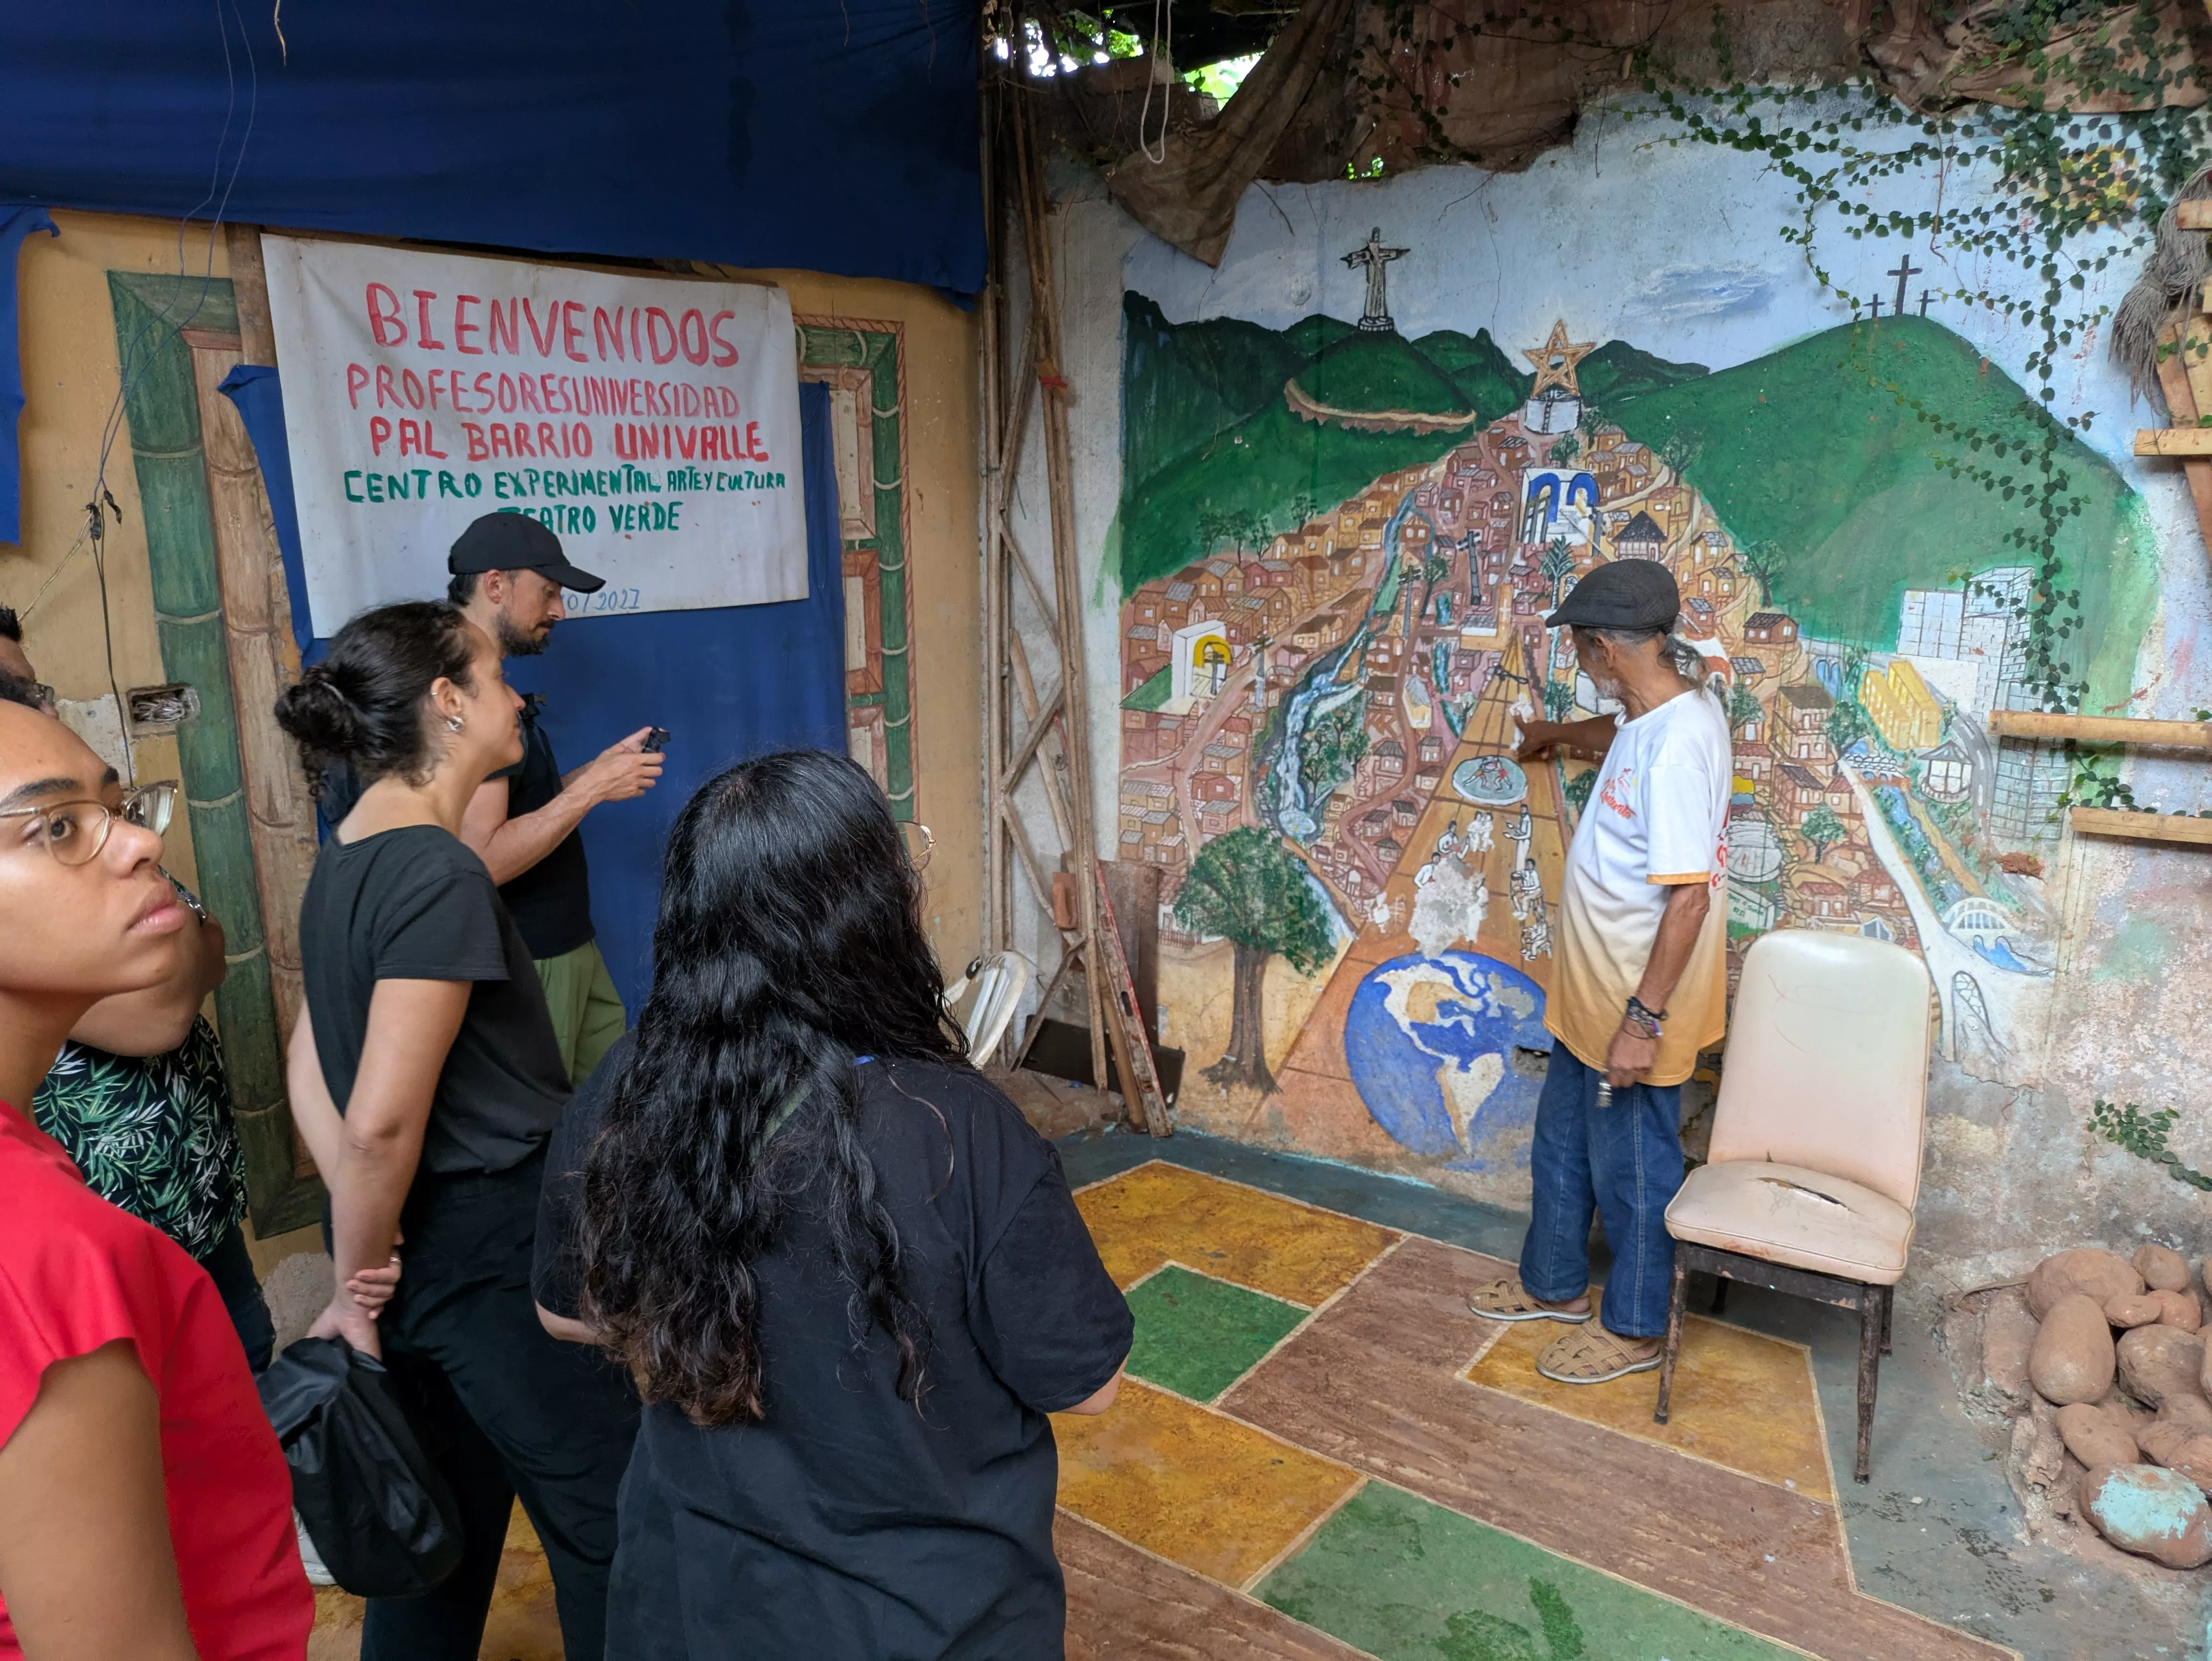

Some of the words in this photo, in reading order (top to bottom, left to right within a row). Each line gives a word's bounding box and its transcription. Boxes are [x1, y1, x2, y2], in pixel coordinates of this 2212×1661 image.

[366, 281, 740, 368] BIENVENIDOS
[370, 416, 448, 460] PAL
[461, 421, 593, 462] BARRIO
[615, 421, 769, 462] UNIVALLE
[344, 468, 482, 503] CENTRO
[494, 464, 661, 499] EXPERIMENTAL
[608, 501, 684, 534] VERDE
